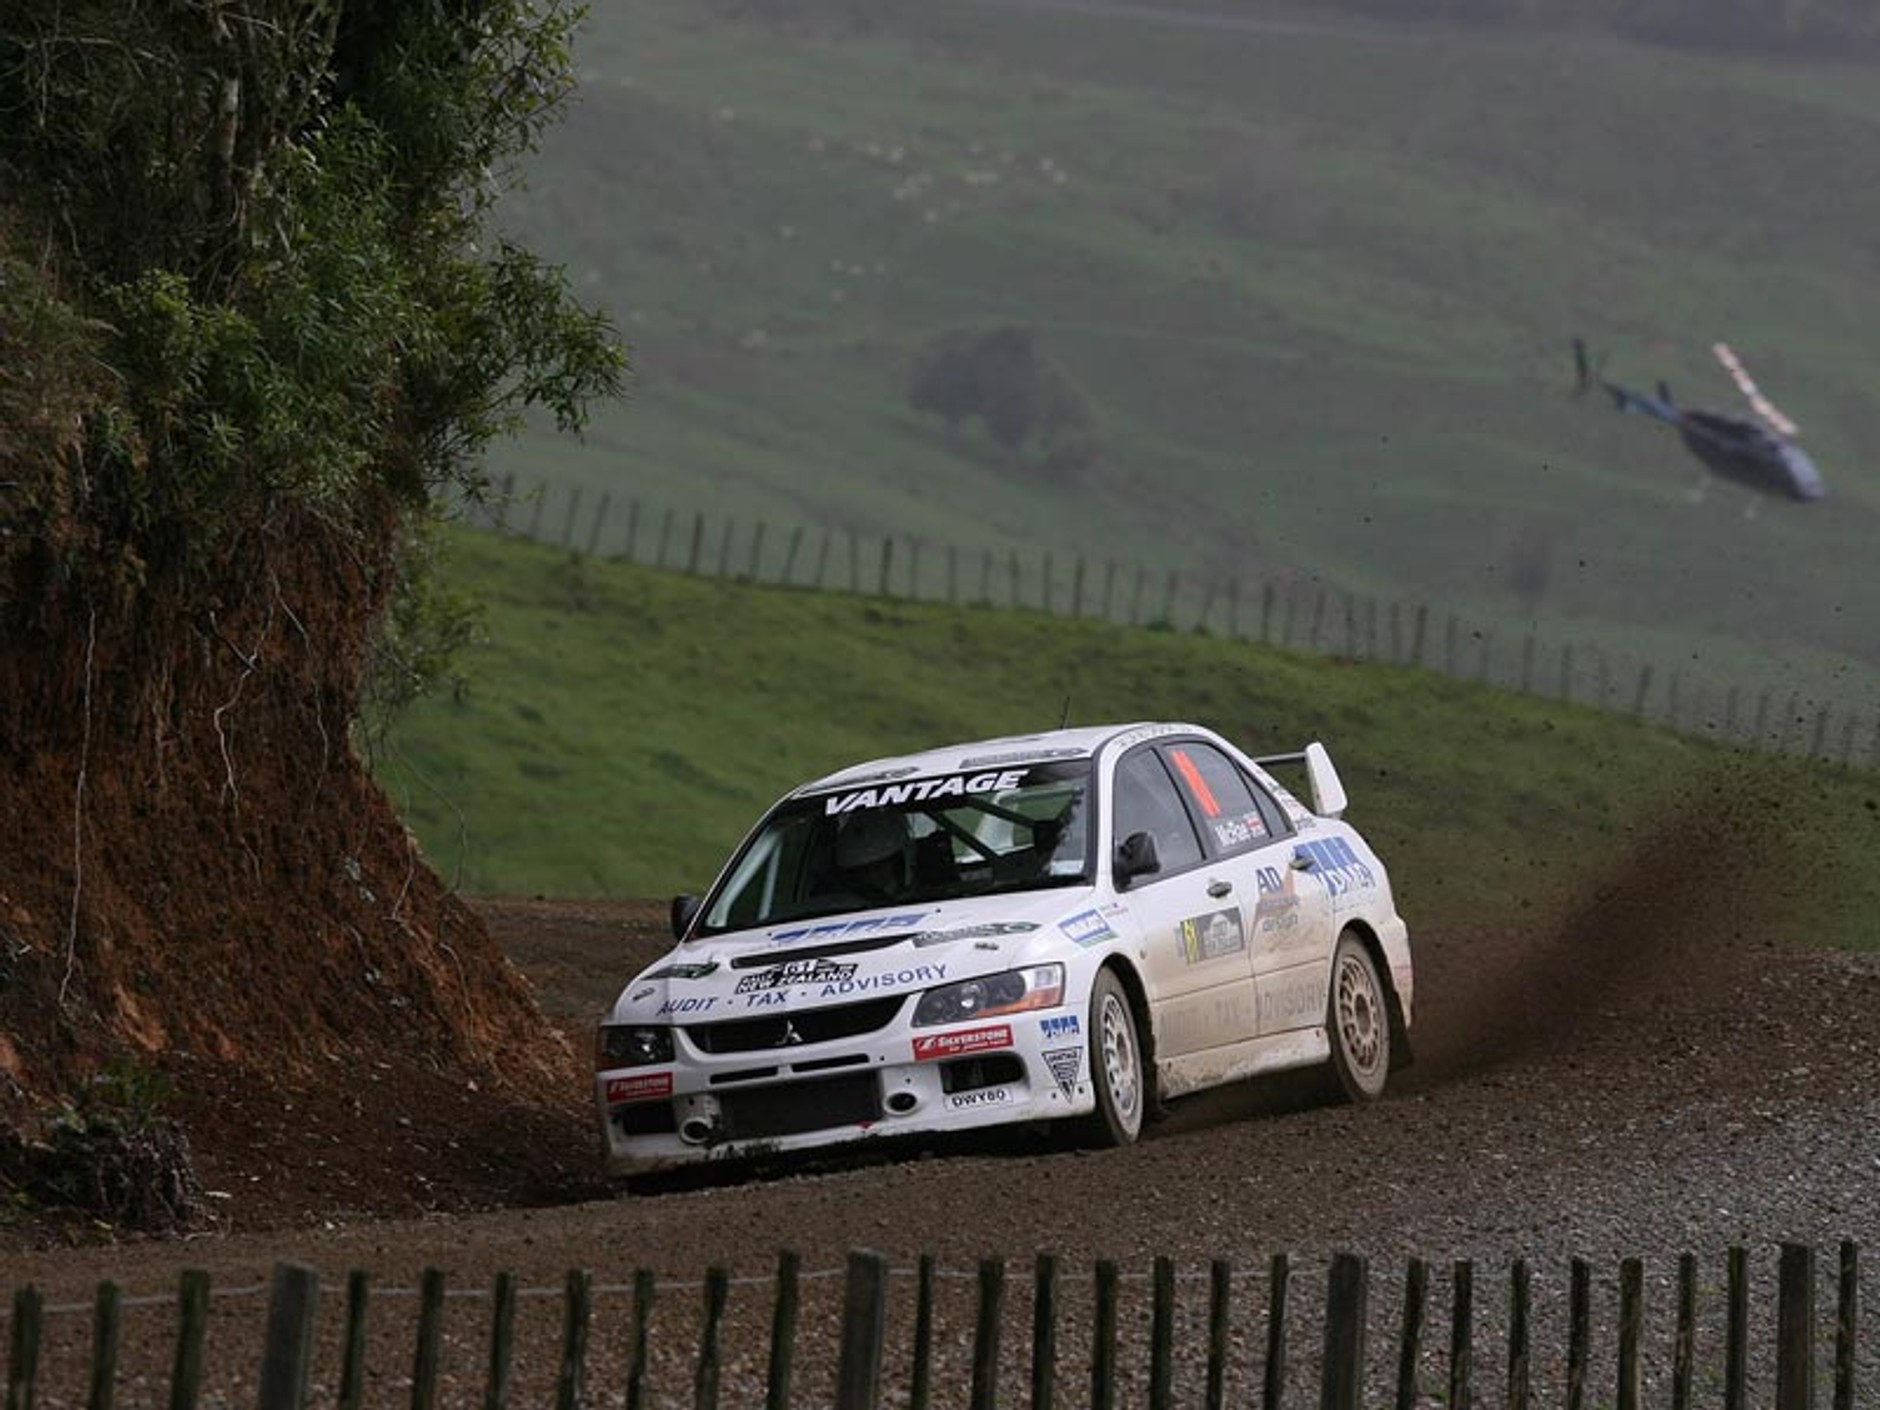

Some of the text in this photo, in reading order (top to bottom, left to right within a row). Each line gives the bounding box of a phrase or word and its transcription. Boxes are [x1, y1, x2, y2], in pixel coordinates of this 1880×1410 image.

[825, 769, 1030, 816] VANTAGE
[1255, 866, 1283, 893] AD
[656, 997, 719, 1016] AUDIT
[746, 989, 789, 1007] TAX
[820, 963, 947, 997] ADVISORY
